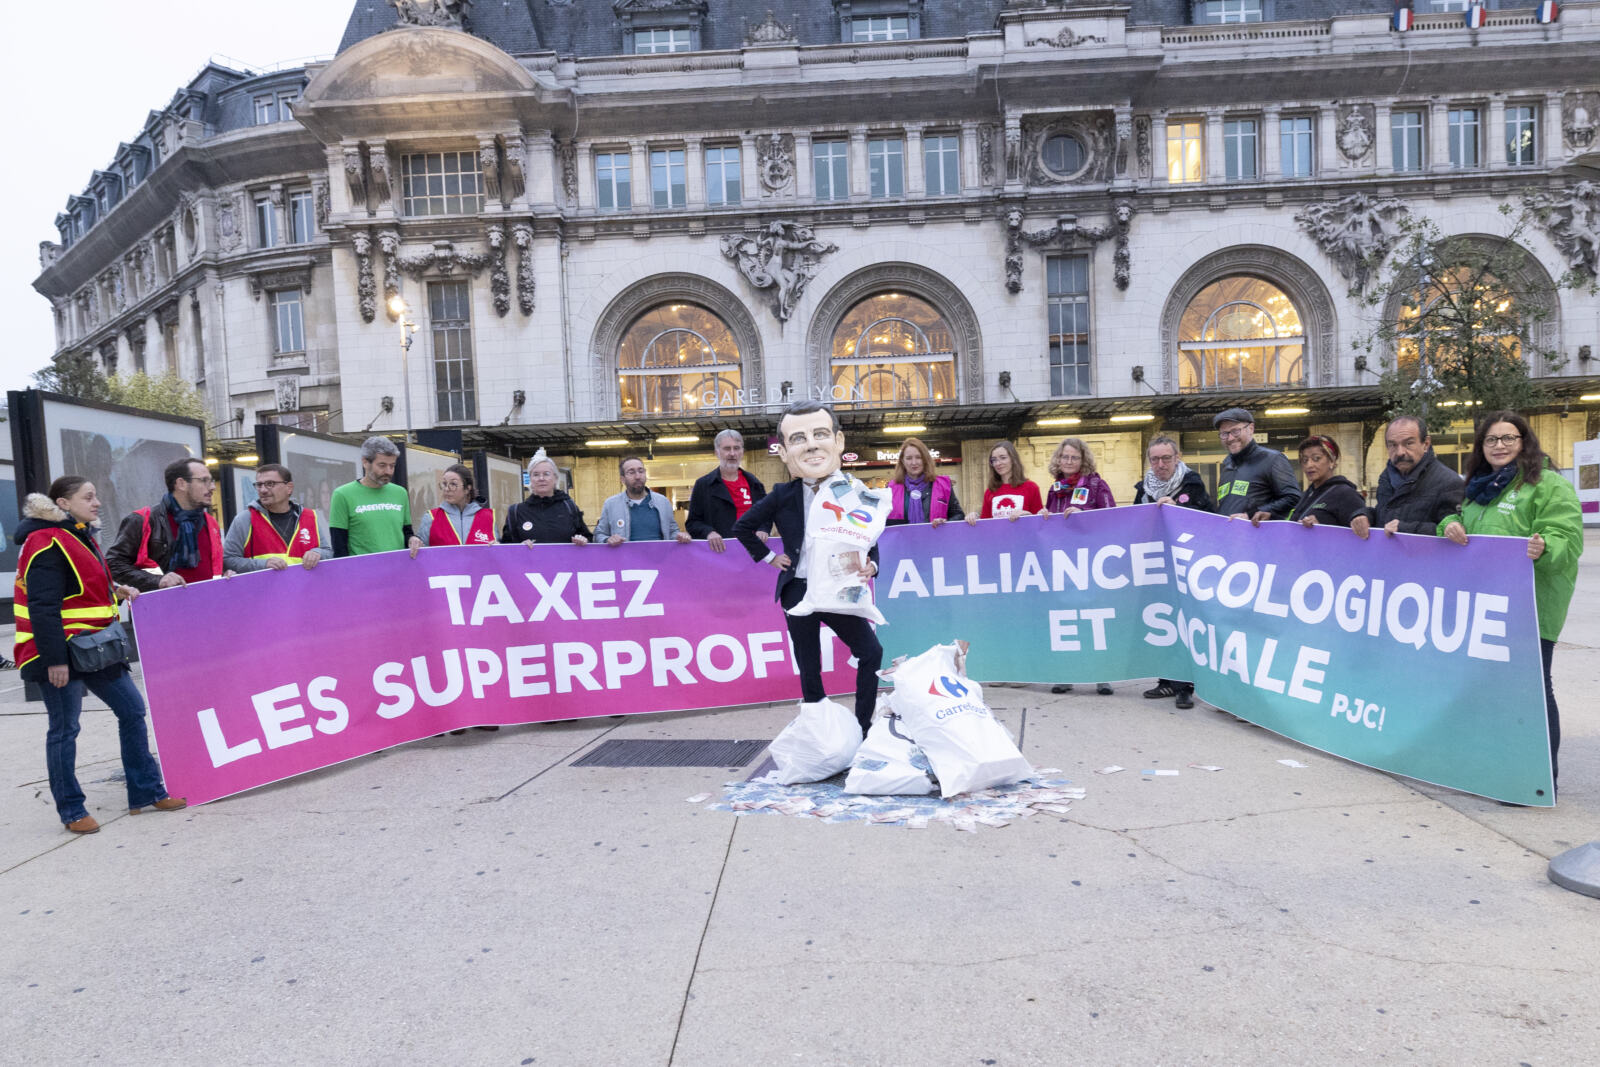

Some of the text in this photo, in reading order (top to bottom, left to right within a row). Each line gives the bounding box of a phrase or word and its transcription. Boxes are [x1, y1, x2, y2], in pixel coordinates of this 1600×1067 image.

[702, 388, 759, 407] GARE
[808, 383, 865, 400] LYON
[429, 569, 665, 626] TAXEZ
[887, 532, 1511, 662] ALLIANCE ÉCOLOGIQUE
[1049, 602, 1332, 705] ET SOCIALE
[197, 621, 876, 769] LES SUPERPROFT
[1330, 692, 1387, 732] PJC!
